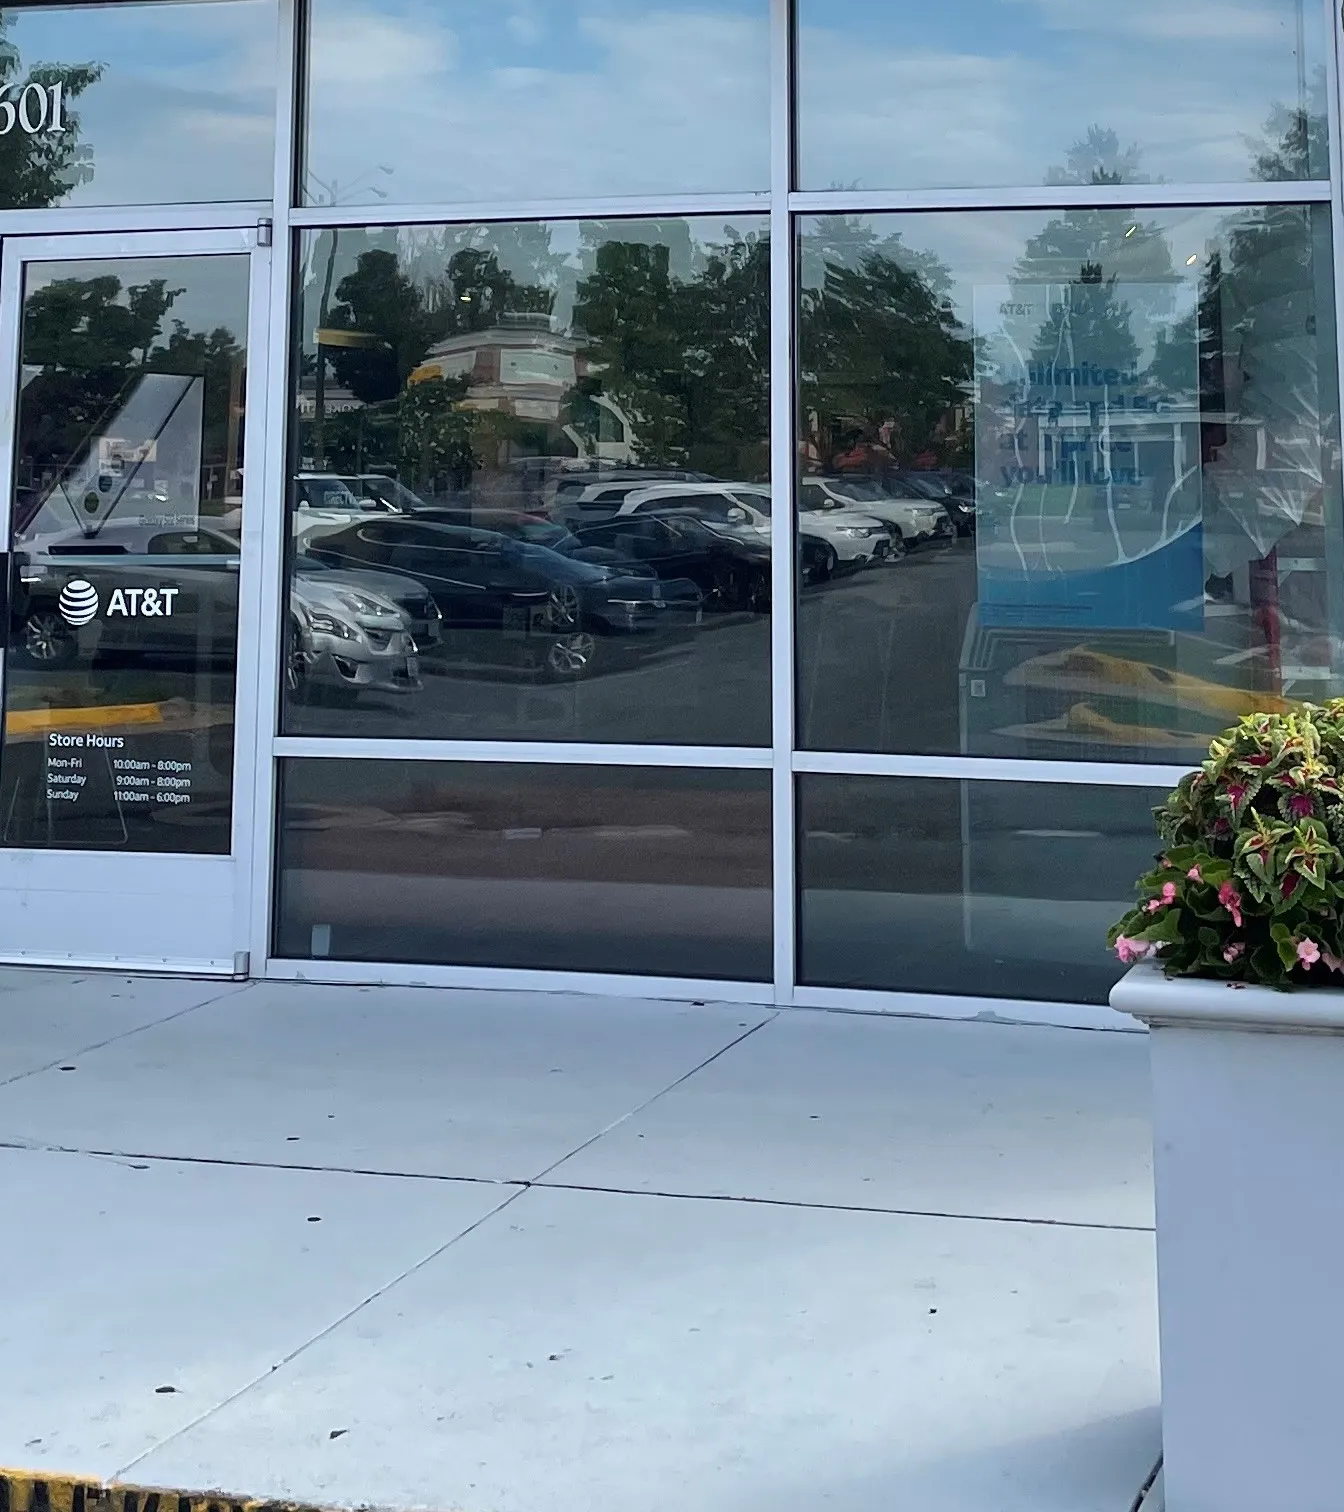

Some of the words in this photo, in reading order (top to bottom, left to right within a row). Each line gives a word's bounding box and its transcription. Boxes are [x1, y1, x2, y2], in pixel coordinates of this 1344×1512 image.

[999, 303, 1034, 316] AT&T
[106, 588, 178, 616] AT&T
[48, 733, 83, 747] Store
[86, 734, 124, 748] Hours
[47, 758, 82, 768] Mon-Fri
[113, 760, 150, 770] 10:00am
[157, 761, 191, 772] 8:00pm
[47, 773, 86, 786] Saturday
[116, 776, 149, 786] 9:00am
[157, 777, 191, 788] 8:00pm
[46, 789, 79, 802] Sunday
[114, 791, 149, 801] 11:00am
[157, 792, 191, 804] 6:00pm
